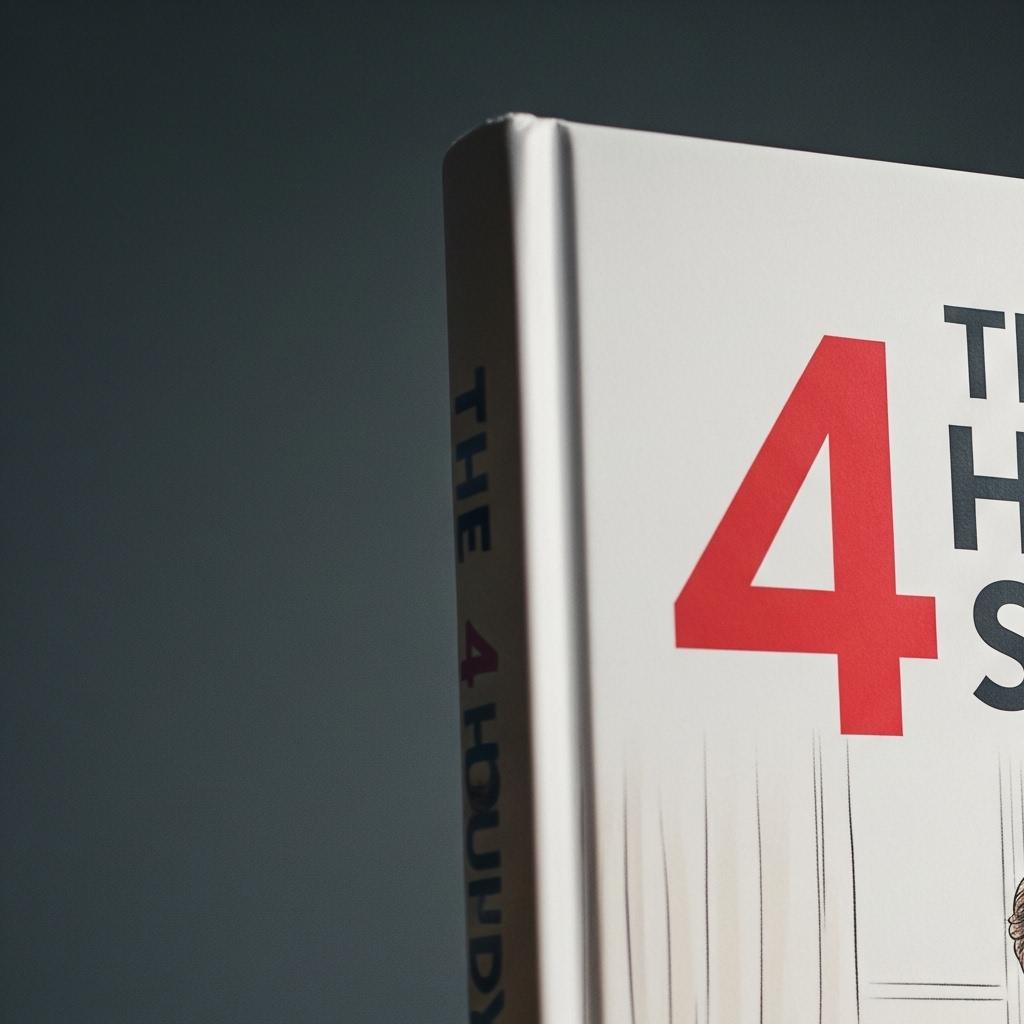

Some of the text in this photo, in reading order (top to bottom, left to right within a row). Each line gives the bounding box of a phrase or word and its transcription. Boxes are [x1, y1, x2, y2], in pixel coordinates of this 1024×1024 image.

[455, 366, 491, 563] THE
[675, 336, 938, 736] 4
[460, 619, 498, 687] 4
